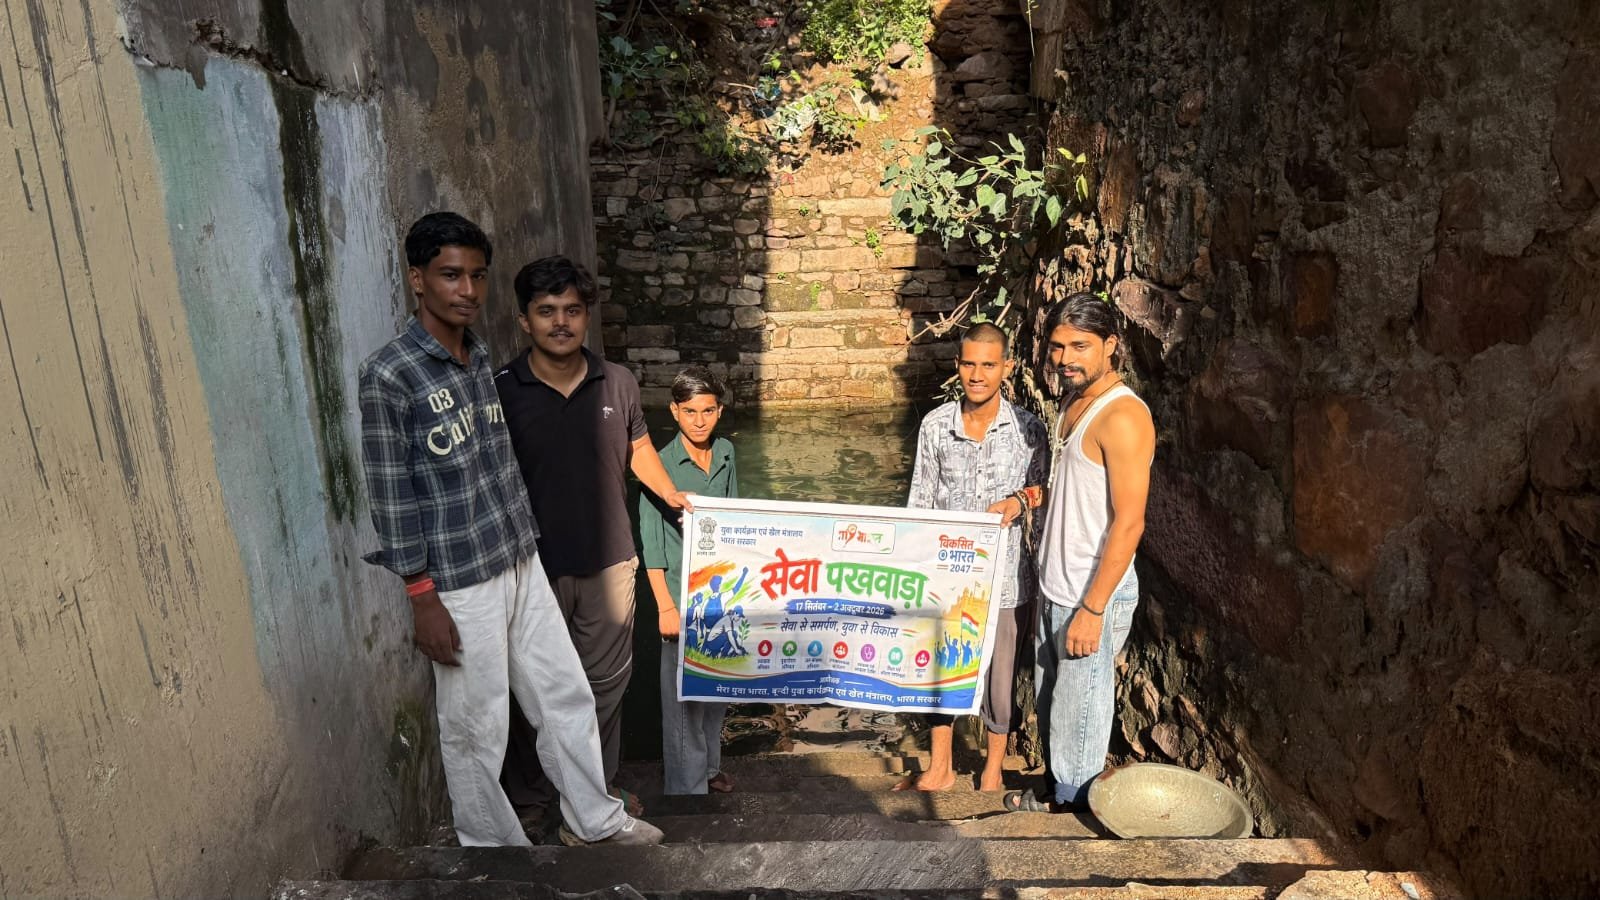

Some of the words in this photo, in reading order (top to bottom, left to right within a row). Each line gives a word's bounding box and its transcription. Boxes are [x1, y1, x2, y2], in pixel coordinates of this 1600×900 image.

[428, 388, 454, 412] 03
[720, 526, 732, 535] युवा
[938, 534, 974, 550] विकसित
[949, 550, 975, 563] भारत
[950, 564, 970, 573] 2047
[760, 548, 822, 600] सेवा
[826, 562, 930, 609] पखवाड़ा
[796, 603, 802, 611] 17
[833, 603, 839, 611] 2
[780, 618, 797, 632] सेवा
[800, 618, 808, 631] से
[841, 622, 858, 636] युवा
[860, 621, 869, 635] से
[871, 622, 899, 638] विकास
[716, 684, 729, 693] मेरा
[731, 687, 746, 696] युवा
[791, 688, 805, 696] युवा
[835, 687, 846, 697] एवं
[848, 688, 864, 698] खेल
[896, 695, 914, 703] भारत
